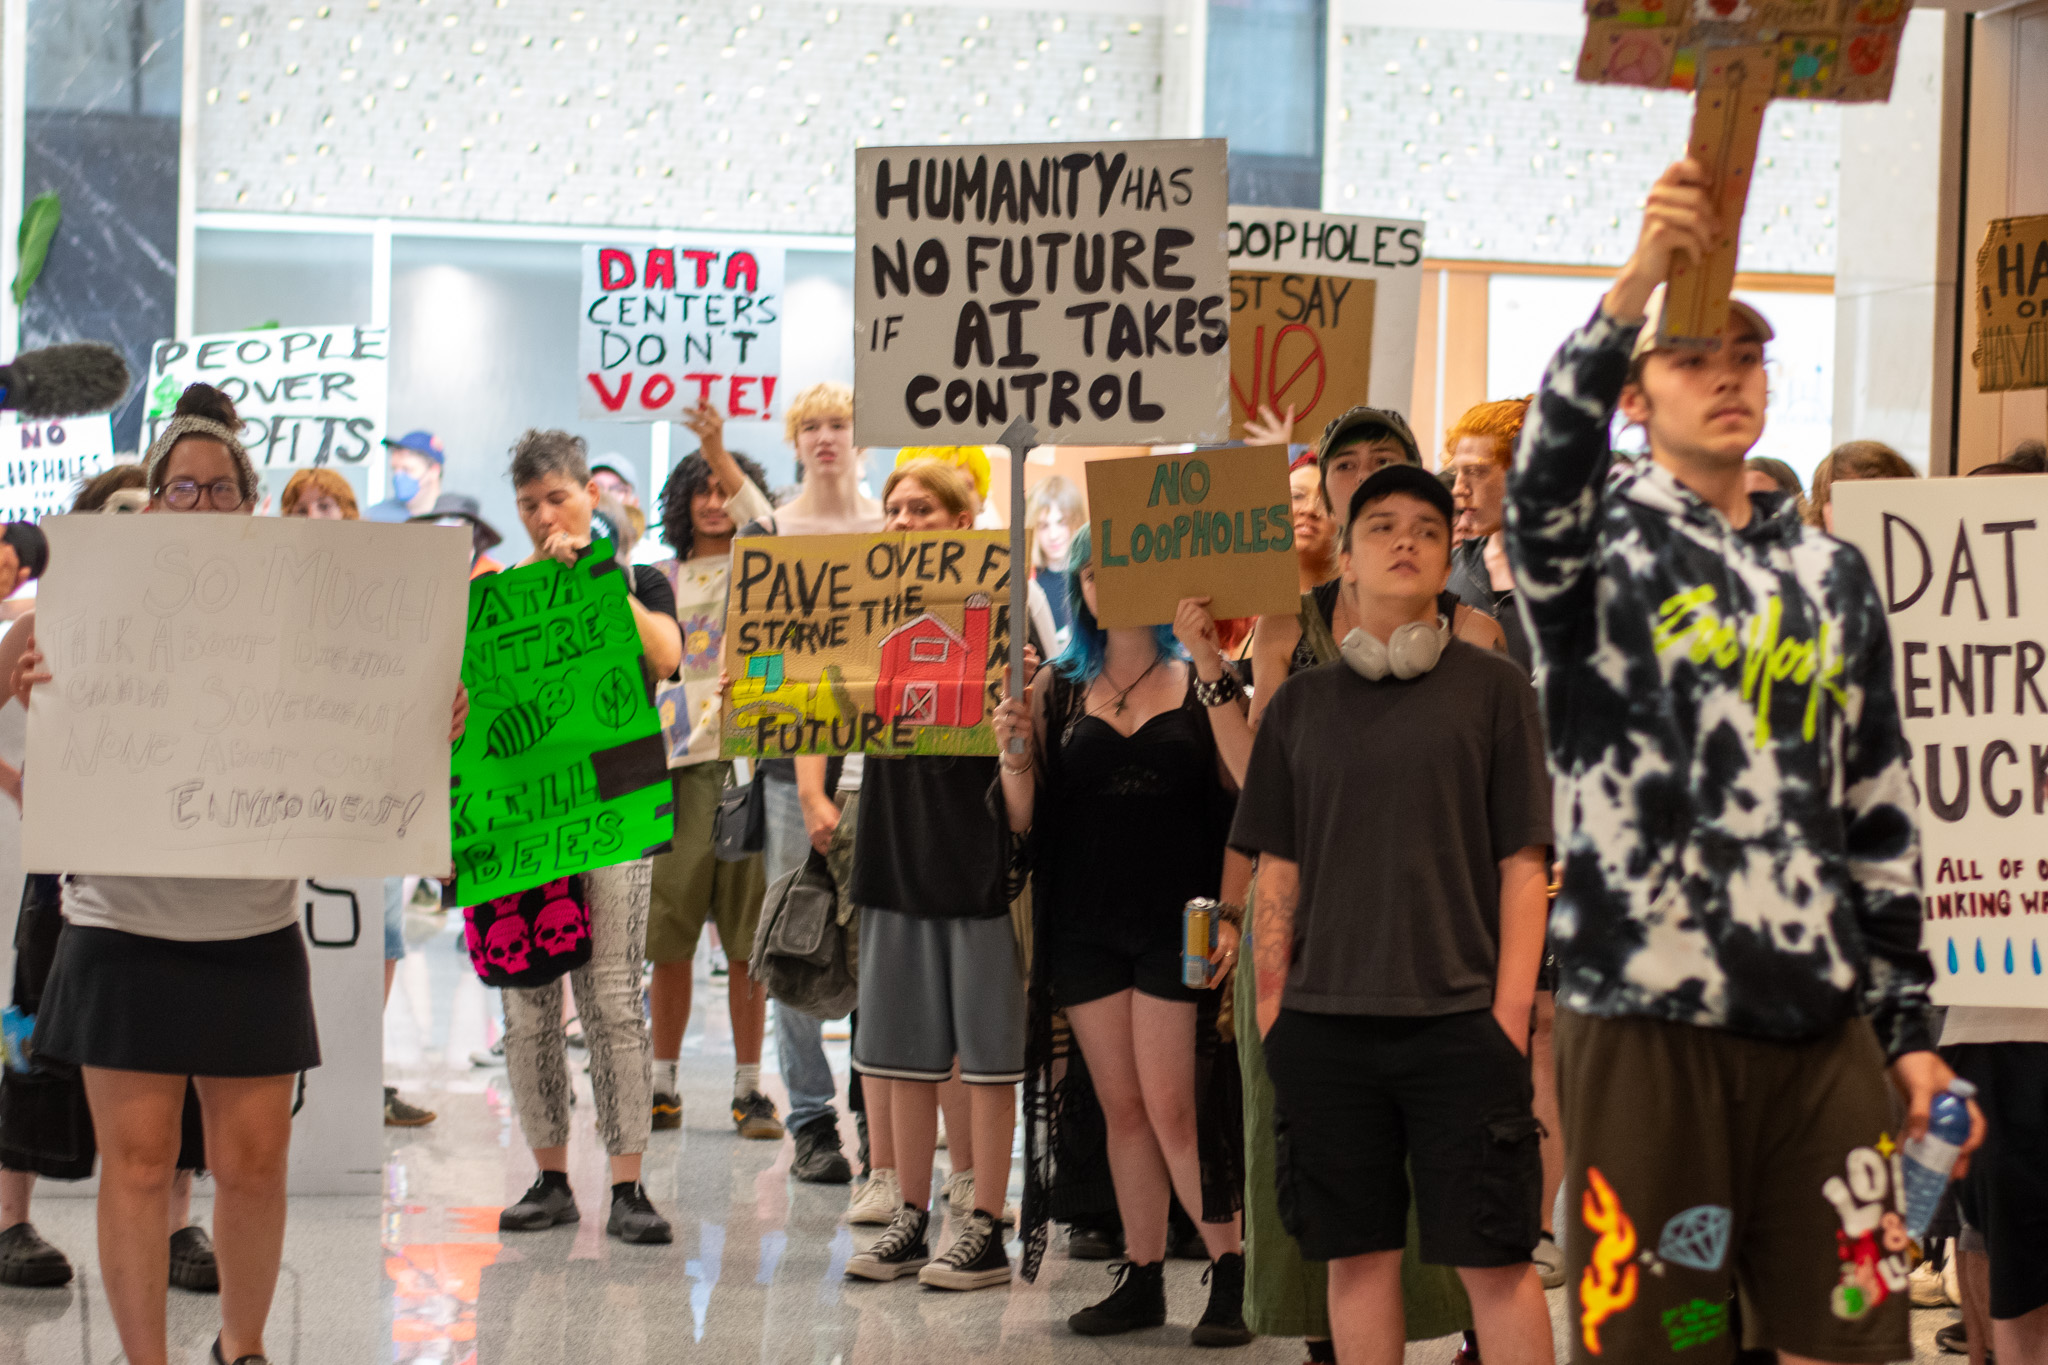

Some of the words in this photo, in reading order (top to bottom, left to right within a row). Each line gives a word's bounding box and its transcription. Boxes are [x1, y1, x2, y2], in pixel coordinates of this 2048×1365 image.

[876, 151, 1127, 224] HUMANITY
[1121, 166, 1194, 212] HAS
[598, 248, 759, 293] DATA
[873, 238, 951, 299] NO
[966, 228, 1196, 295] FUTURE
[1228, 220, 1421, 267] OOPHOLES
[588, 293, 778, 326] CENTERS
[1230, 276, 1272, 312] ST
[1276, 275, 1352, 328] SAY
[156, 326, 387, 375] PEOPLE
[600, 329, 759, 370] DON'T
[870, 315, 904, 352] IF
[953, 300, 1041, 369] AI
[1065, 296, 1229, 362] TAKES
[214, 372, 358, 404] OVER
[587, 372, 778, 420] VOTE!
[905, 370, 1166, 429] CONTROL
[0, 454, 101, 488] OOPHOLES
[1146, 459, 1211, 508] NO
[1101, 504, 1294, 568] LOOPHOLES
[142, 541, 241, 617] SO
[260, 544, 440, 644] MUCH
[736, 550, 852, 617] PAVE
[866, 541, 966, 584] OVER
[1881, 509, 2037, 621] DAT
[470, 569, 584, 632] ATA
[737, 615, 851, 654] STARVE
[859, 585, 927, 635] THE
[464, 592, 636, 689] NTRES
[1903, 640, 2048, 719] ENTR
[757, 712, 916, 753] FUTURE
[463, 808, 625, 885] BEES
[1936, 856, 1984, 884] ALL
[1999, 858, 2024, 881] OF
[1925, 889, 2011, 921] INKING
